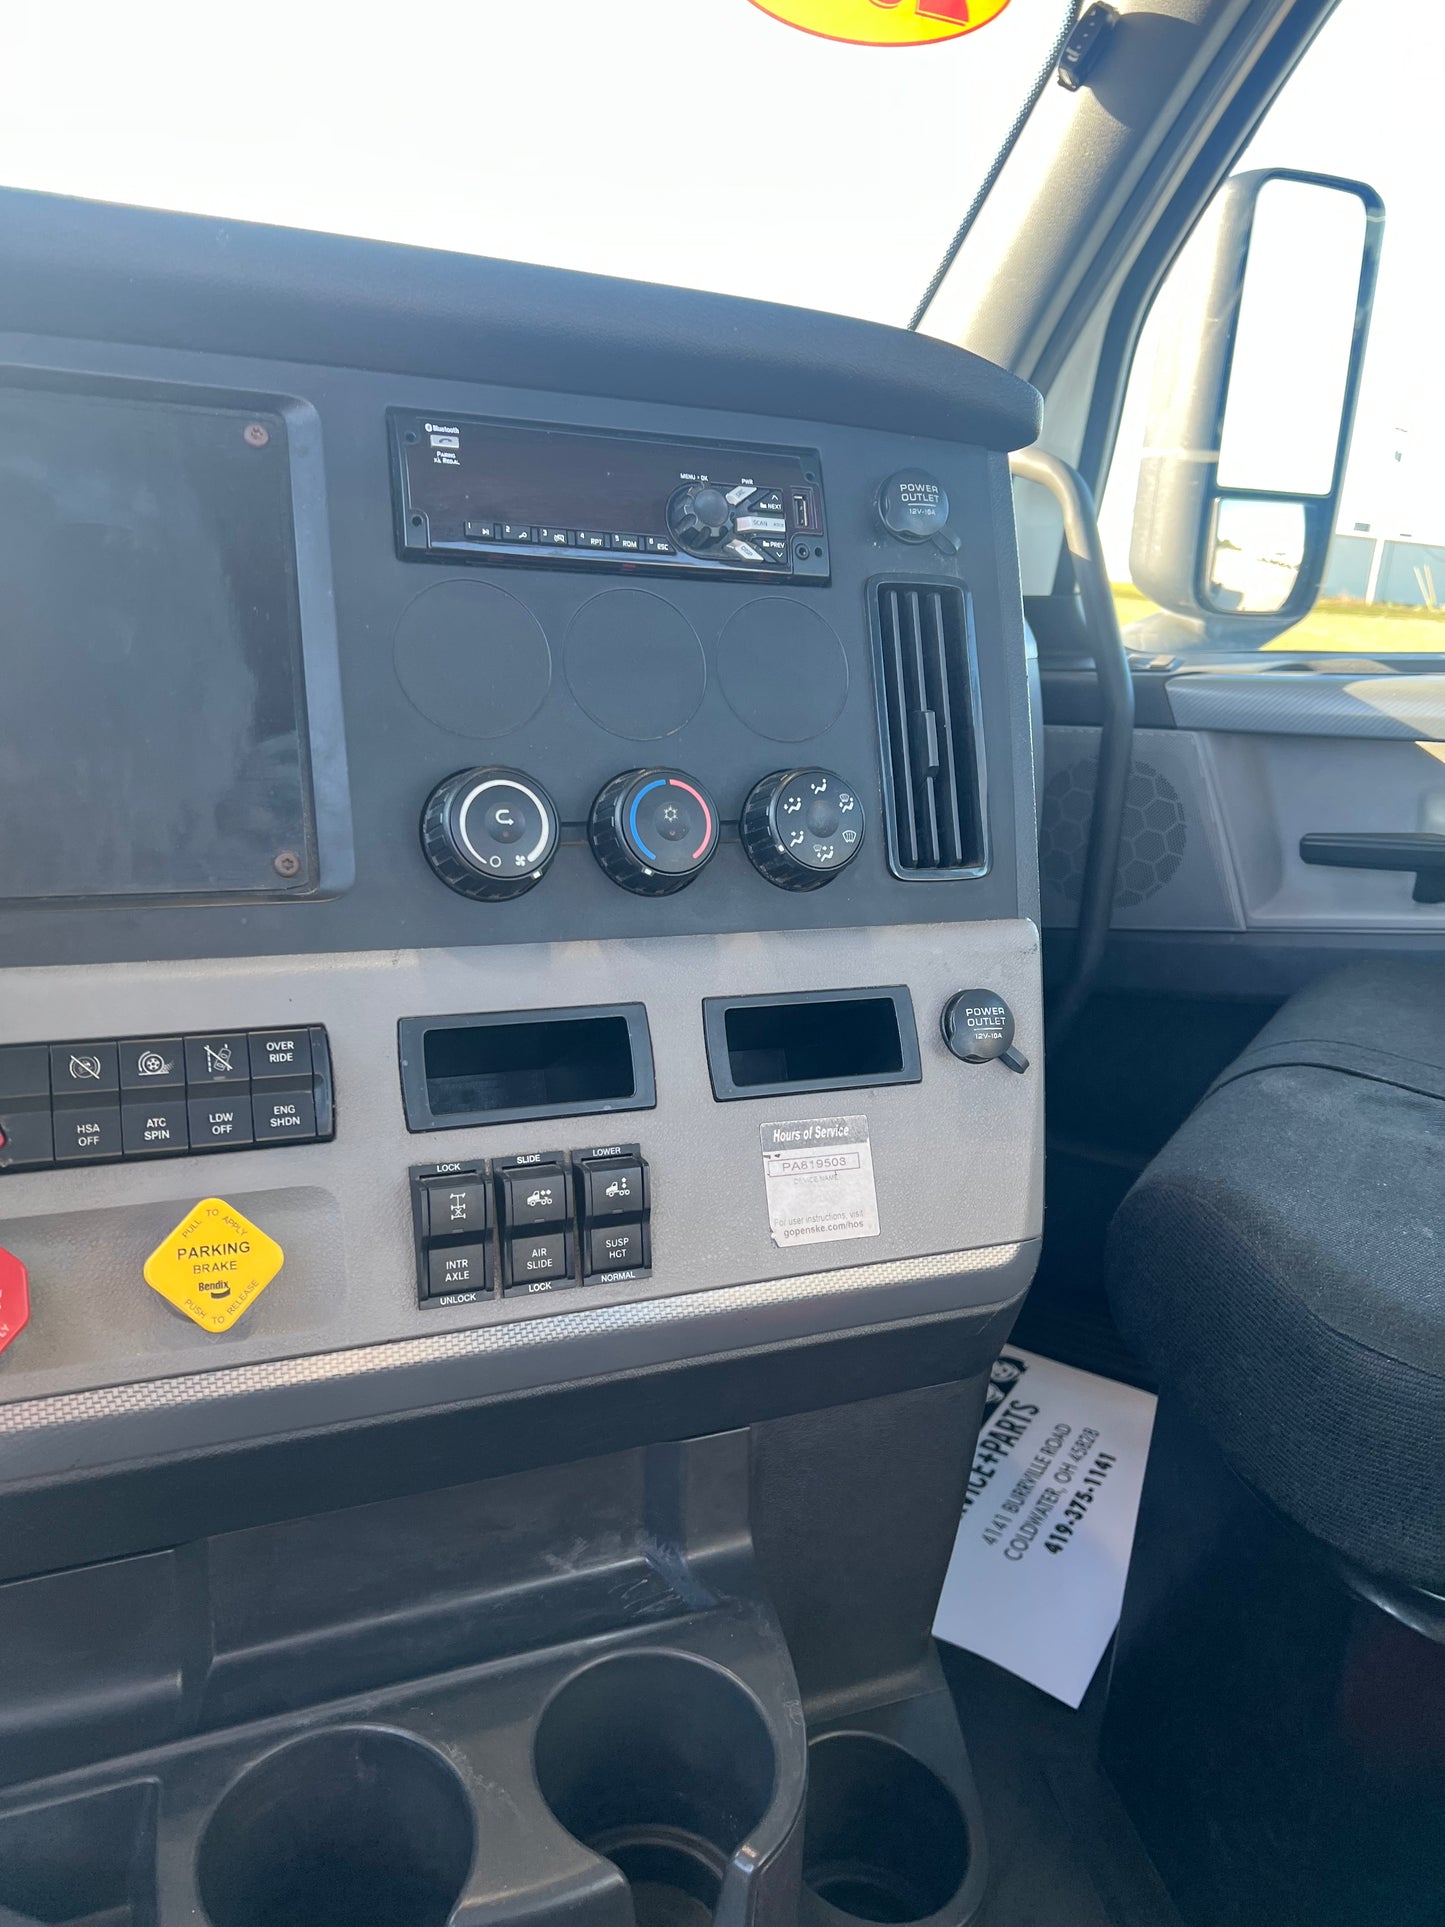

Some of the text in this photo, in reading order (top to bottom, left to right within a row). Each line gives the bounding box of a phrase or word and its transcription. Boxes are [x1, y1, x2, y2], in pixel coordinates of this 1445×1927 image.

[900, 483, 939, 494] POWER
[901, 493, 940, 503] OUTLET
[753, 519, 768, 528] SCAN
[770, 541, 785, 549] PREV
[965, 1007, 1005, 1017] POWER
[967, 1017, 1006, 1027] OUTLET
[975, 1032, 1003, 1040] 12V-10A
[266, 1040, 295, 1052] OVER
[269, 1052, 294, 1064] RIDE
[273, 1104, 296, 1116] ENG
[146, 1117, 167, 1129] ATC
[209, 1112, 234, 1124] LDW
[270, 1116, 301, 1128] SHDN
[76, 1123, 101, 1135] HSA
[144, 1129, 170, 1141] SPIN
[212, 1124, 233, 1136] OFF
[773, 1124, 850, 1143] Hours of Service
[78, 1135, 100, 1147] OFF
[592, 1146, 621, 1157] LOWER
[516, 1154, 541, 1165] SLIDE
[436, 1163, 461, 1173] LOCK
[182, 1208, 248, 1239] PULL TO APPLY
[784, 1220, 864, 1239] gopenske.com/hos
[605, 1237, 630, 1248] SUSP
[177, 1241, 251, 1261] PARKING
[531, 1247, 548, 1258] AIR
[609, 1248, 627, 1259] HGT
[193, 1260, 238, 1275] BRAKE
[446, 1259, 469, 1270] INTR
[526, 1258, 553, 1270] SLIDE
[445, 1270, 470, 1282] AXLE
[601, 1271, 636, 1283] NORMAL
[198, 1280, 230, 1292] Bendix
[528, 1281, 552, 1293] LOCK
[185, 1279, 260, 1325] PUSH TO RELEASE
[440, 1292, 477, 1305] UNLOCK
[1054, 1462, 1078, 1484] OH
[981, 1423, 1072, 1546] 4141 BURRVILLE ROAD
